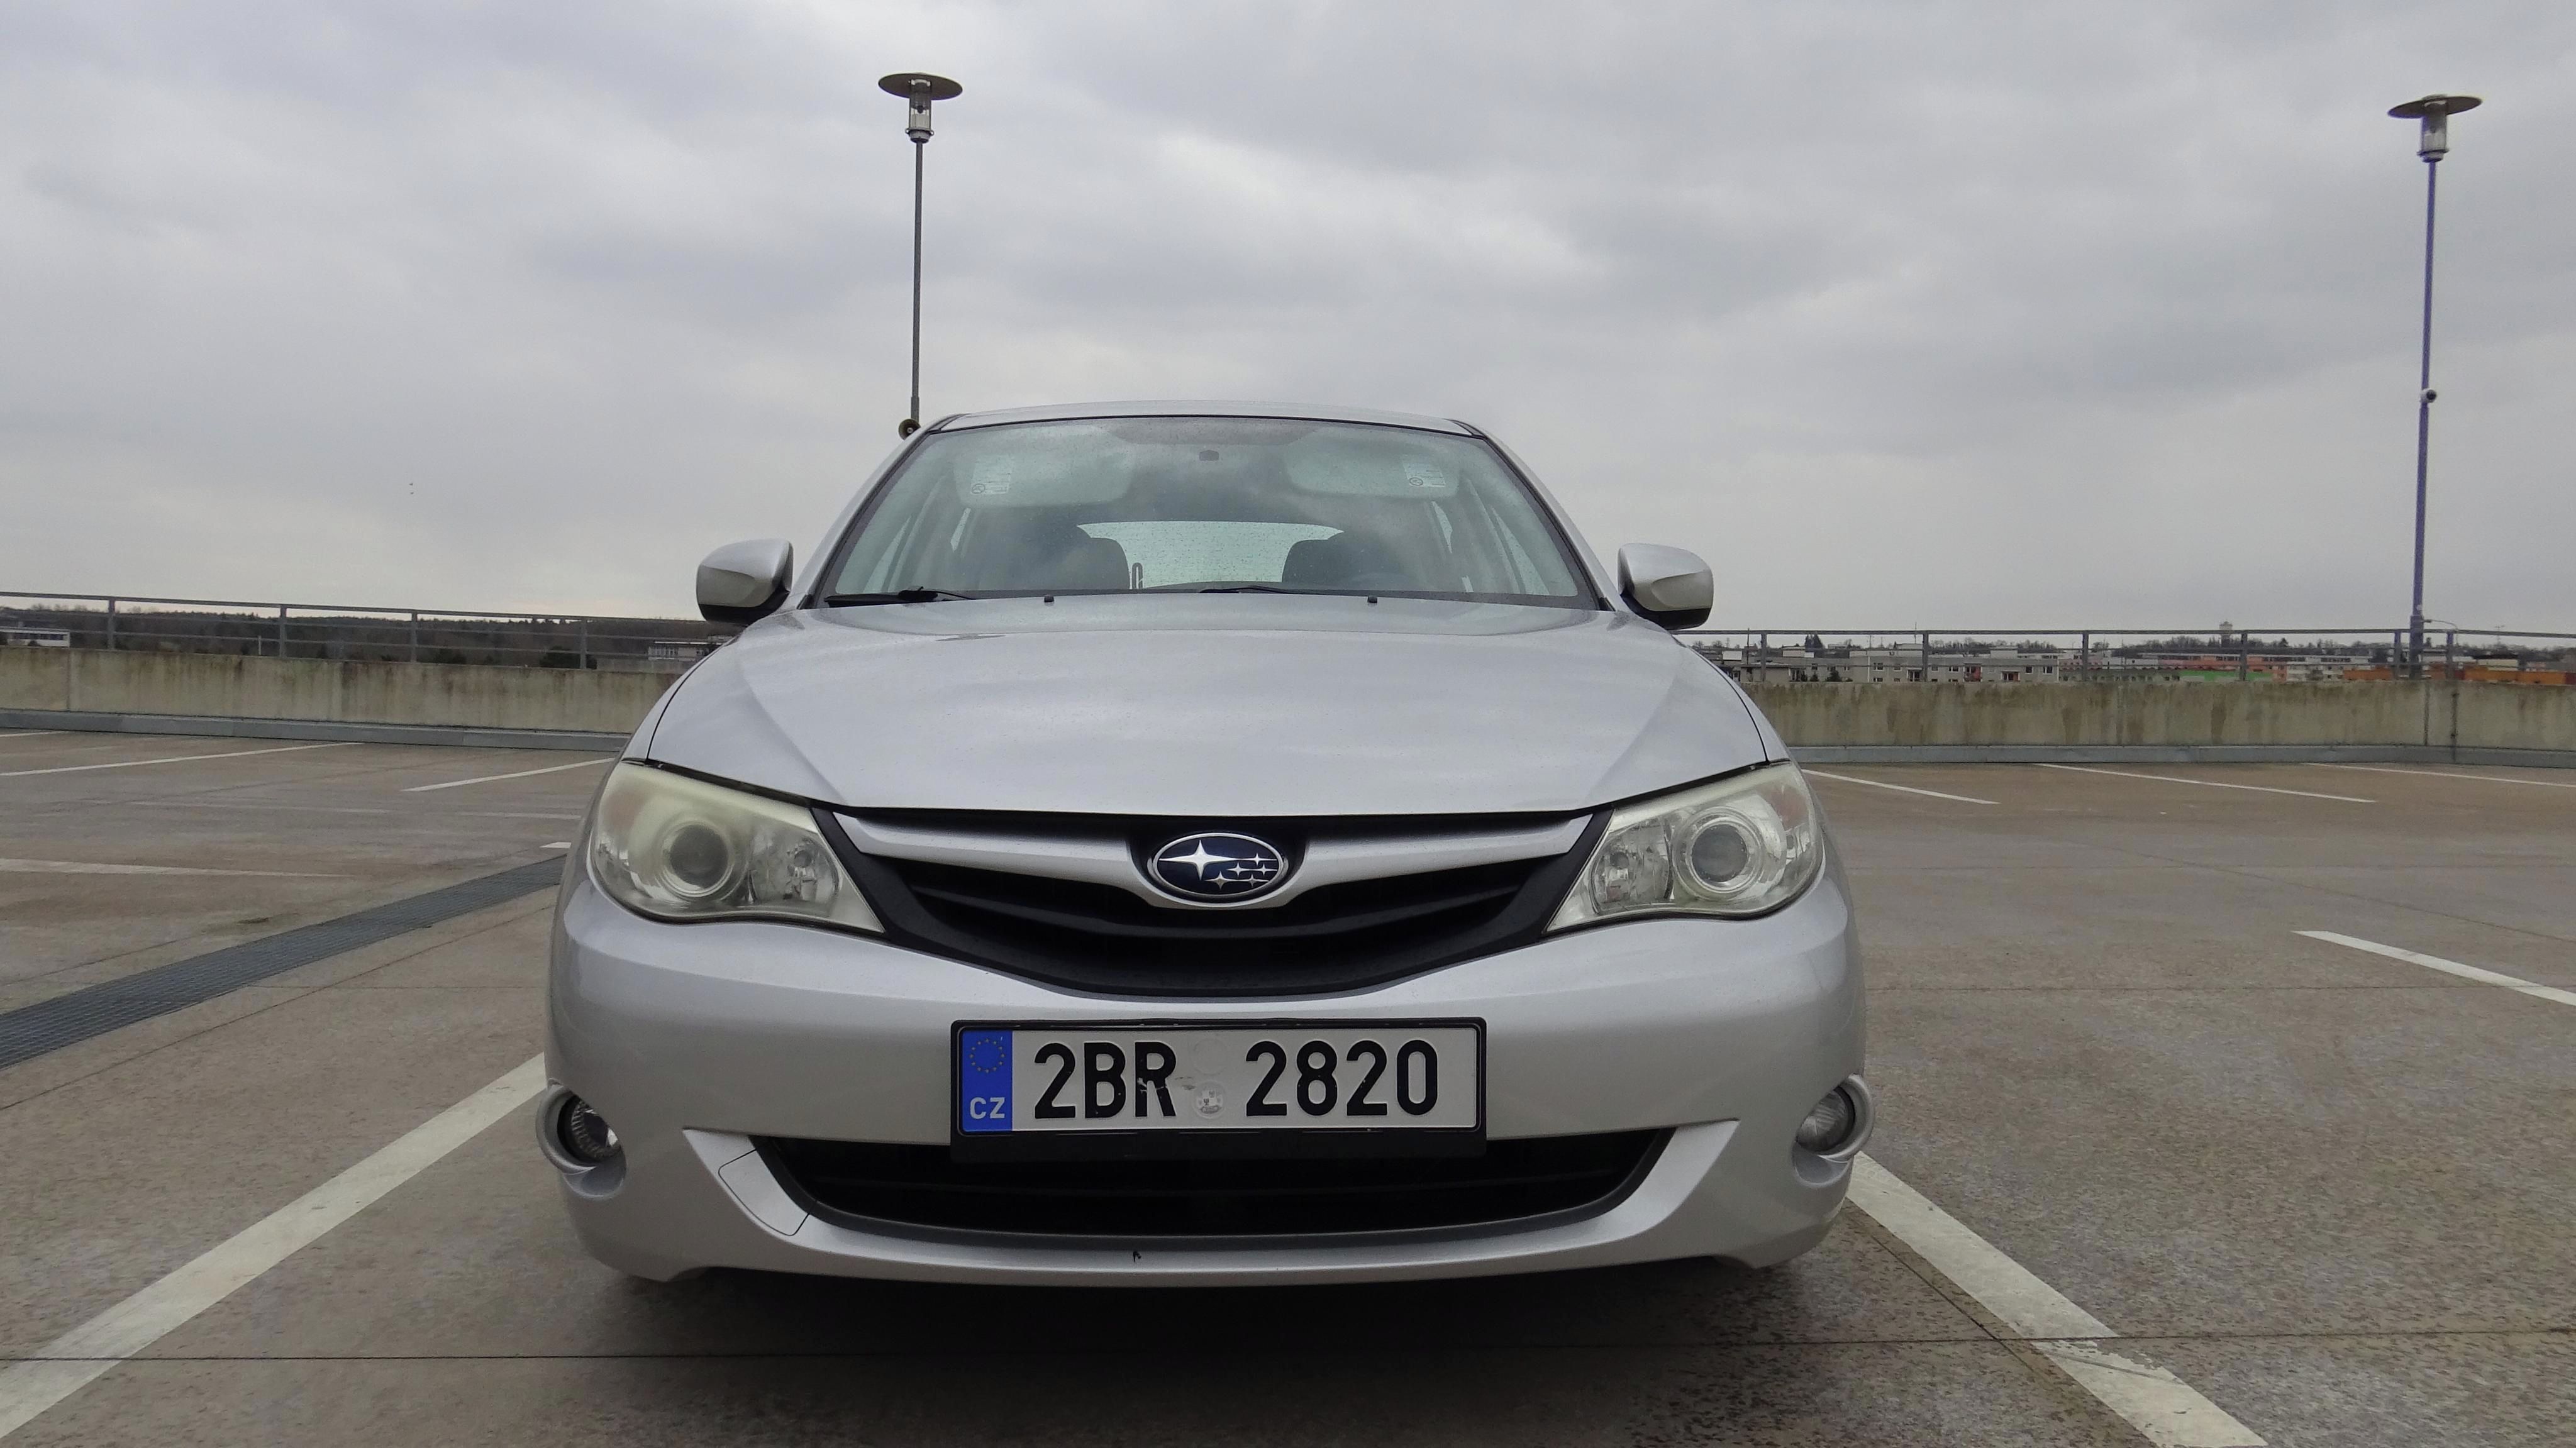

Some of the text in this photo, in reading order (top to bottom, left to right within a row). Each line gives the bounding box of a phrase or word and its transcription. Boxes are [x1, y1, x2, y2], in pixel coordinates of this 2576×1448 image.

[1034, 1039, 1438, 1119] 2BR 2820
[970, 1097, 1006, 1120] CZ
